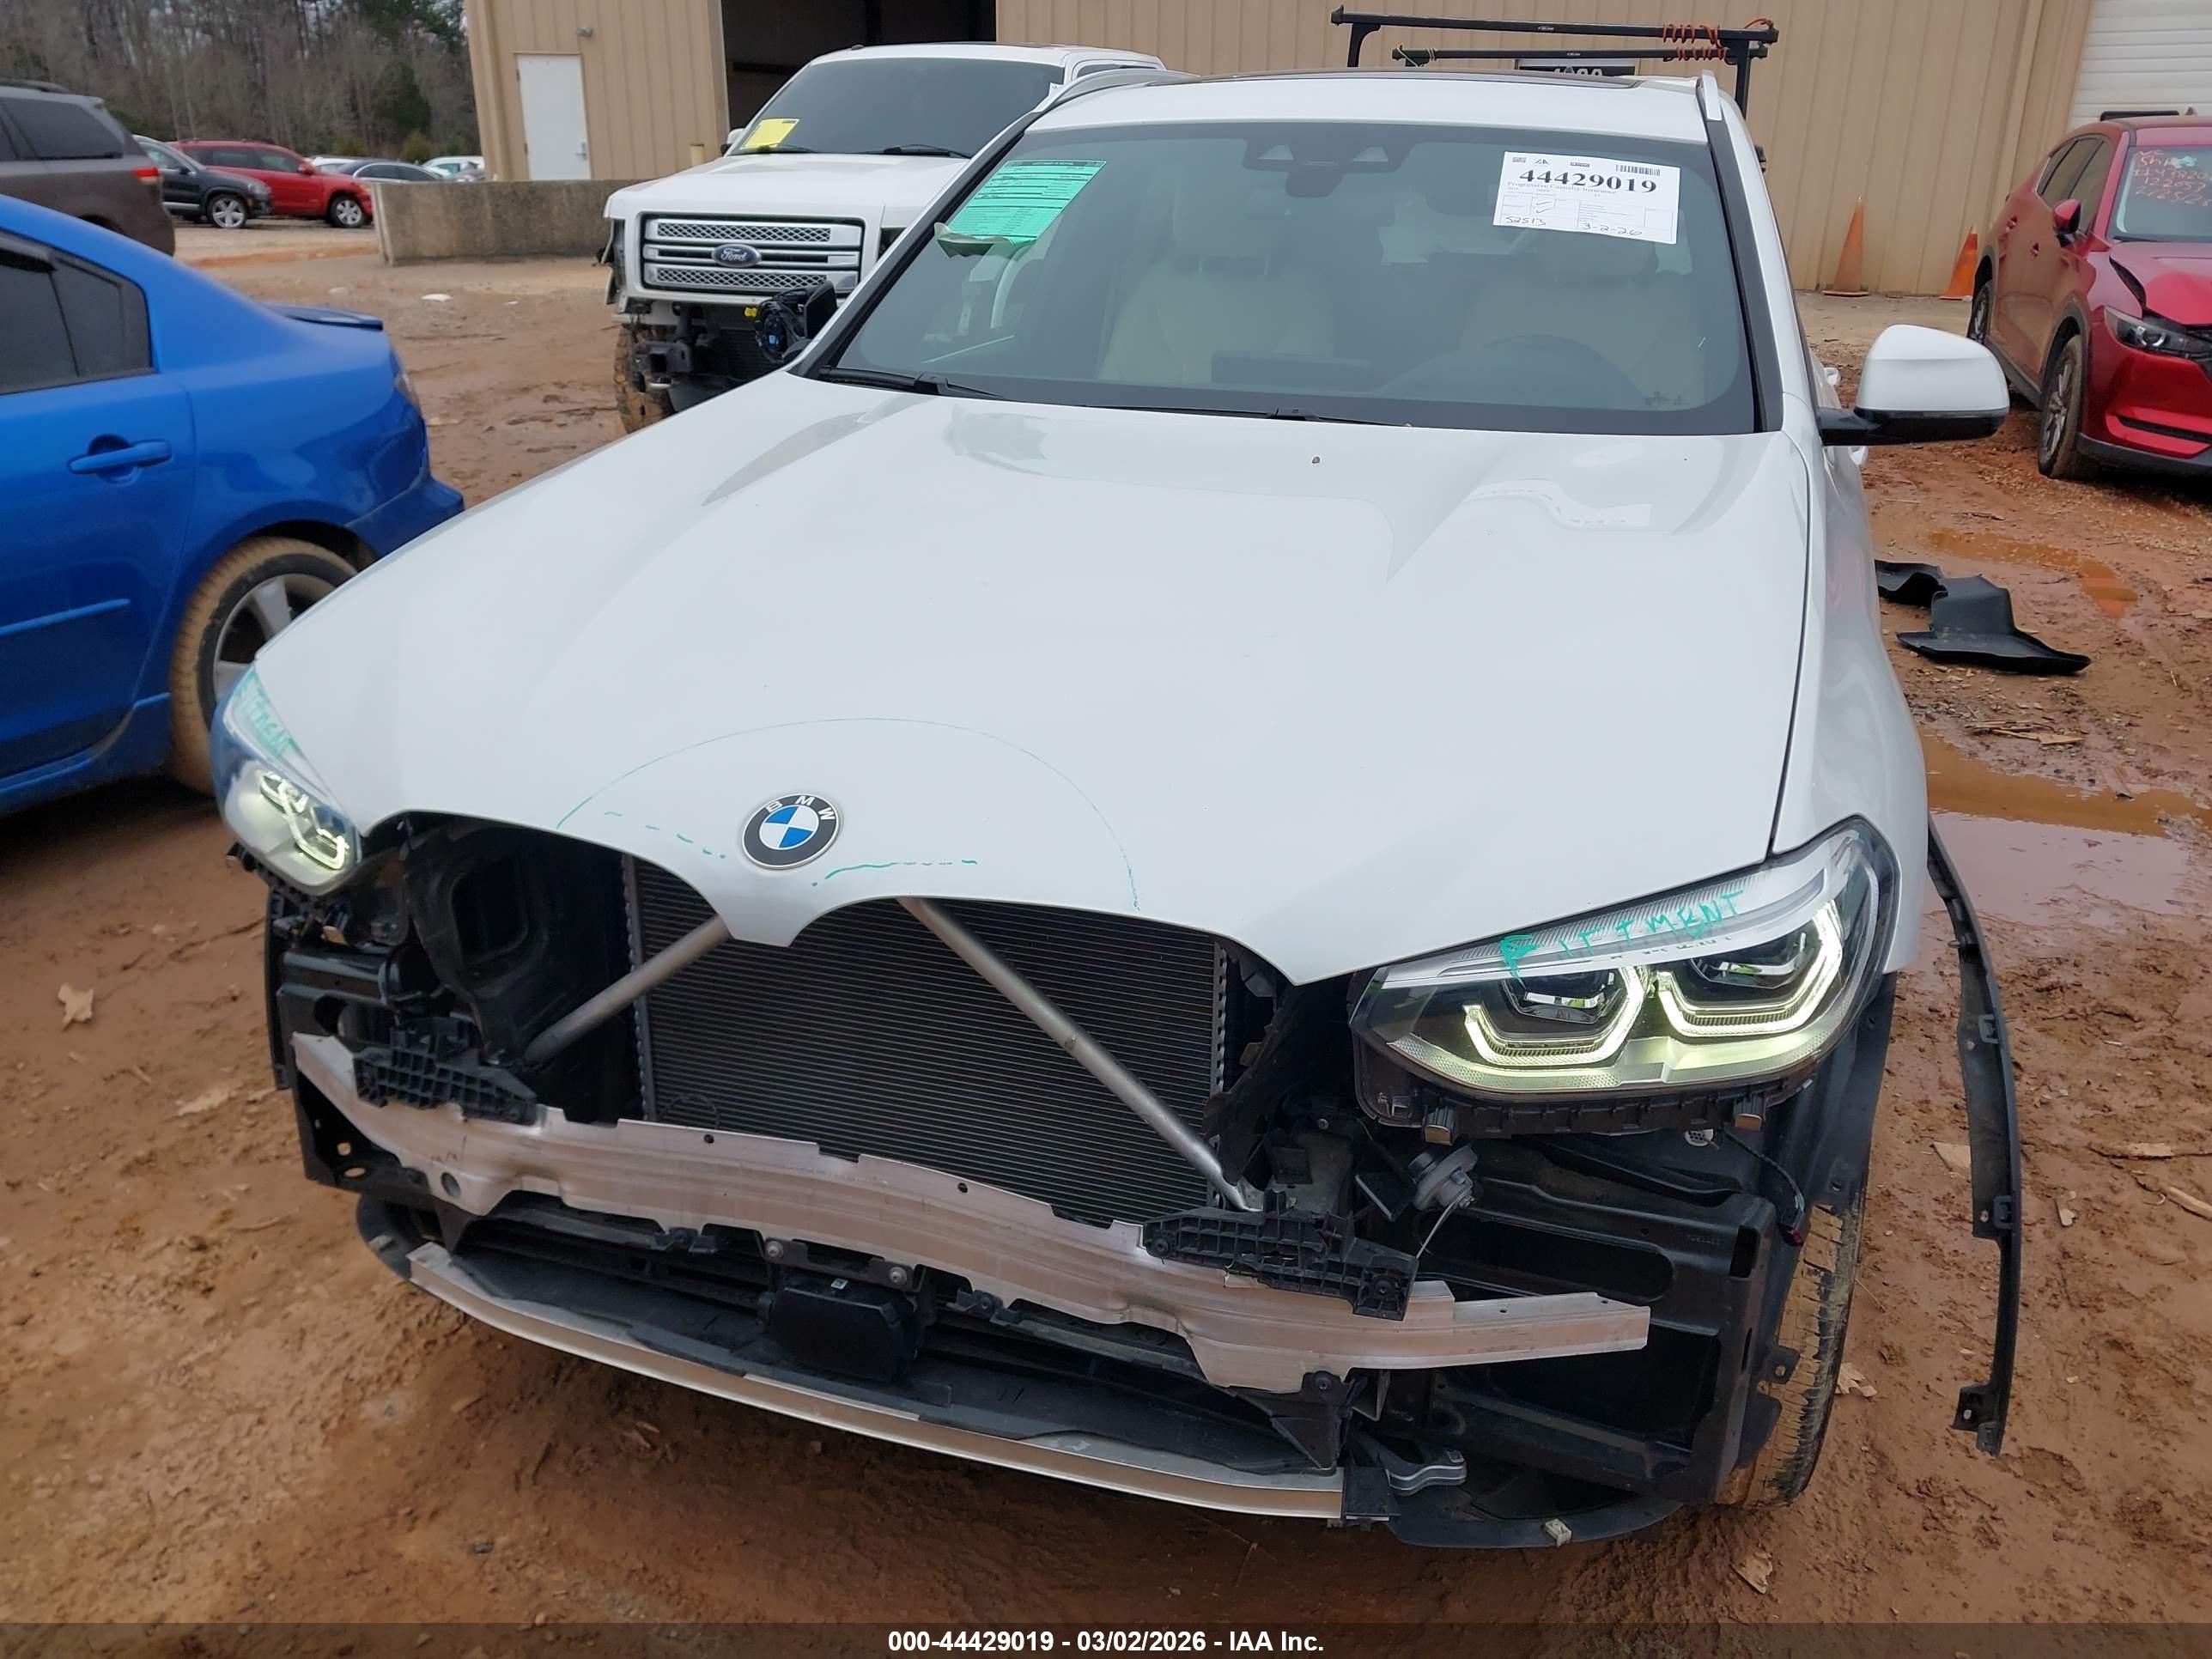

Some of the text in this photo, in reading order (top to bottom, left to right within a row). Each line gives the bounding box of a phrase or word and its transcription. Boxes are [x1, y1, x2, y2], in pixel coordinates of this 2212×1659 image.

[1519, 169, 1656, 193] 44429019
[1582, 222, 1642, 236] 3-2-26
[720, 247, 747, 261] Ford
[765, 795, 836, 820] BMW
